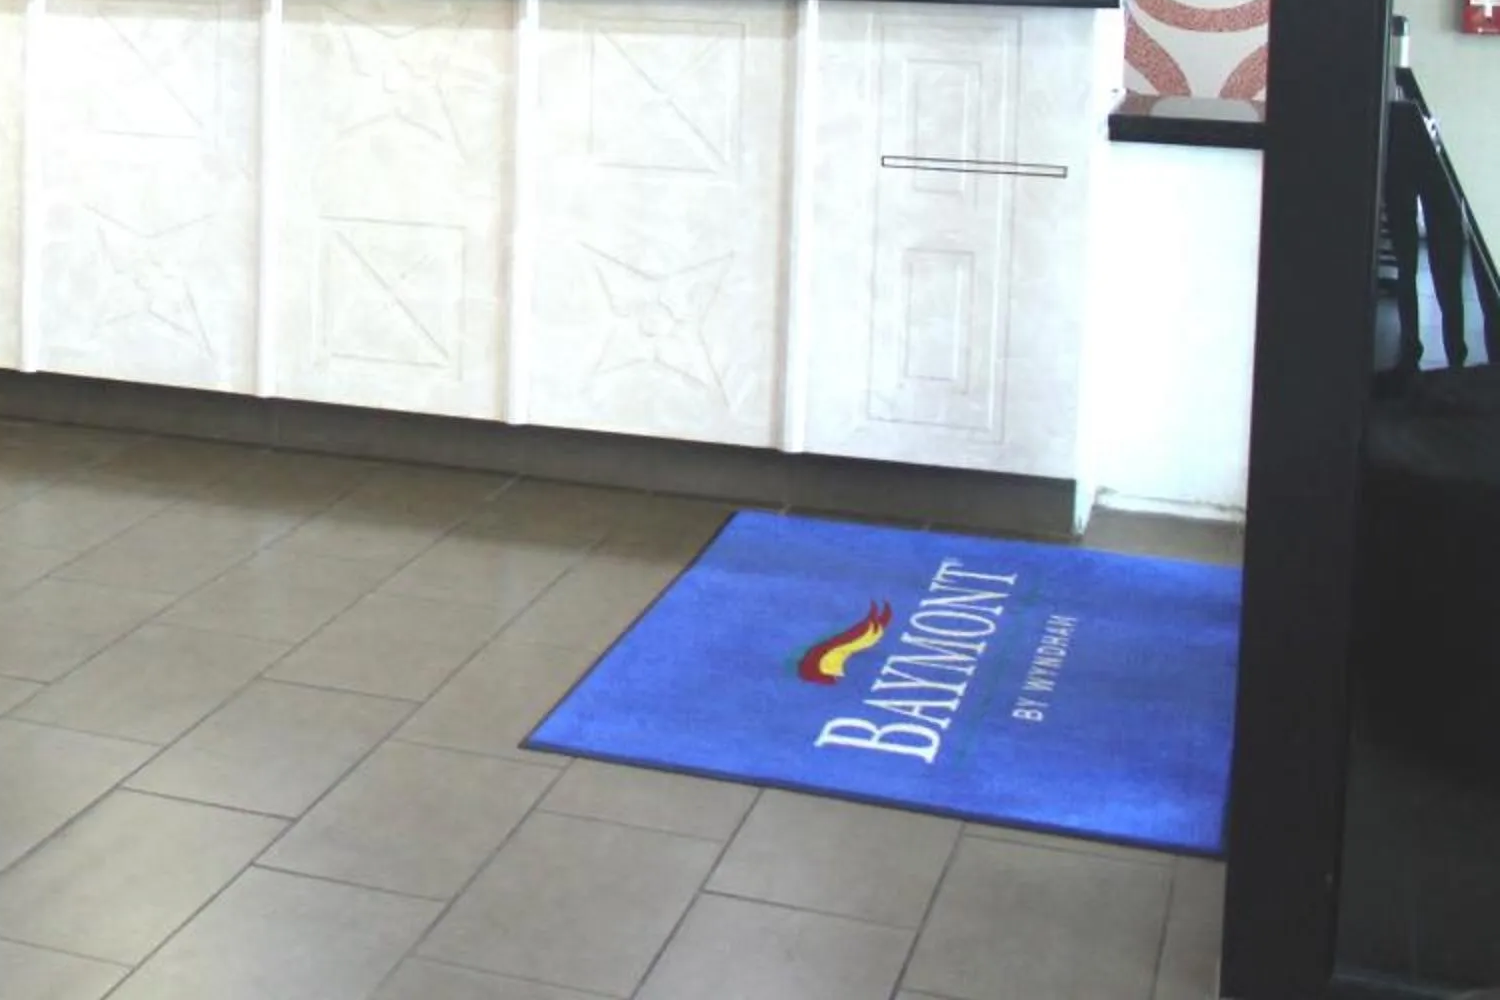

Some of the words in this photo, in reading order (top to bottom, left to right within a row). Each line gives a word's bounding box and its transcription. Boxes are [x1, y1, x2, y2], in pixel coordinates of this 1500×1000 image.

[814, 557, 1018, 764] BAYMONT
[1021, 615, 1077, 691] WYNDHAM
[1012, 696, 1050, 721] BY
